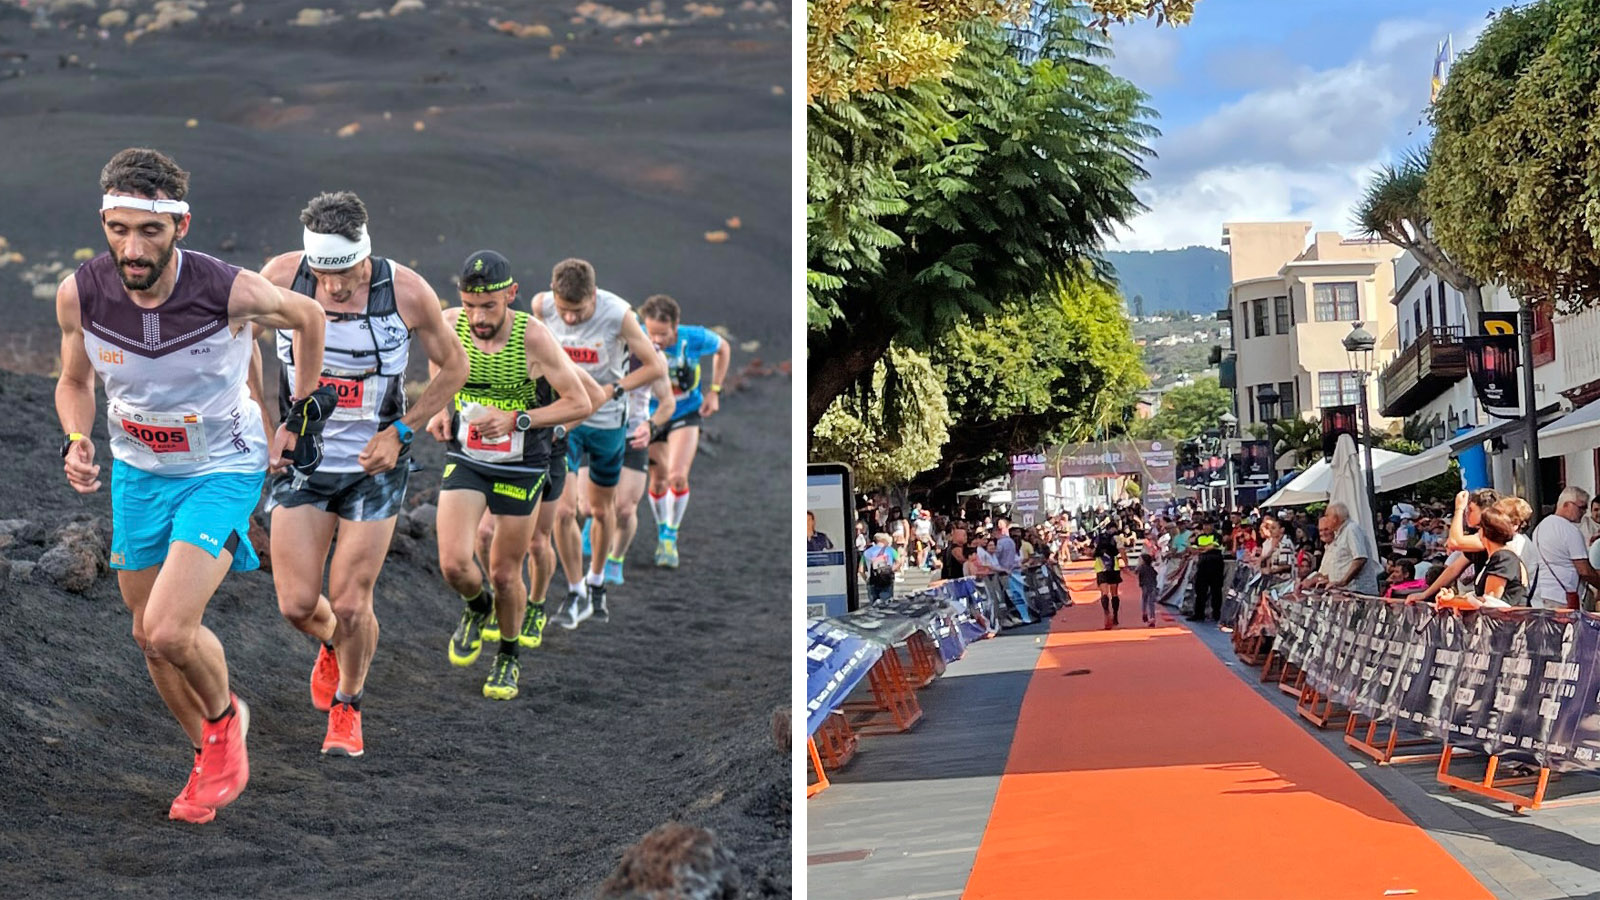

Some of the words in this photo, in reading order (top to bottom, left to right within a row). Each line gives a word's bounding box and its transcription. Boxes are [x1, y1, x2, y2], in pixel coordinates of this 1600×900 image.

[317, 251, 358, 265] TERREX
[98, 347, 124, 365] iati
[127, 425, 185, 443] 3005
